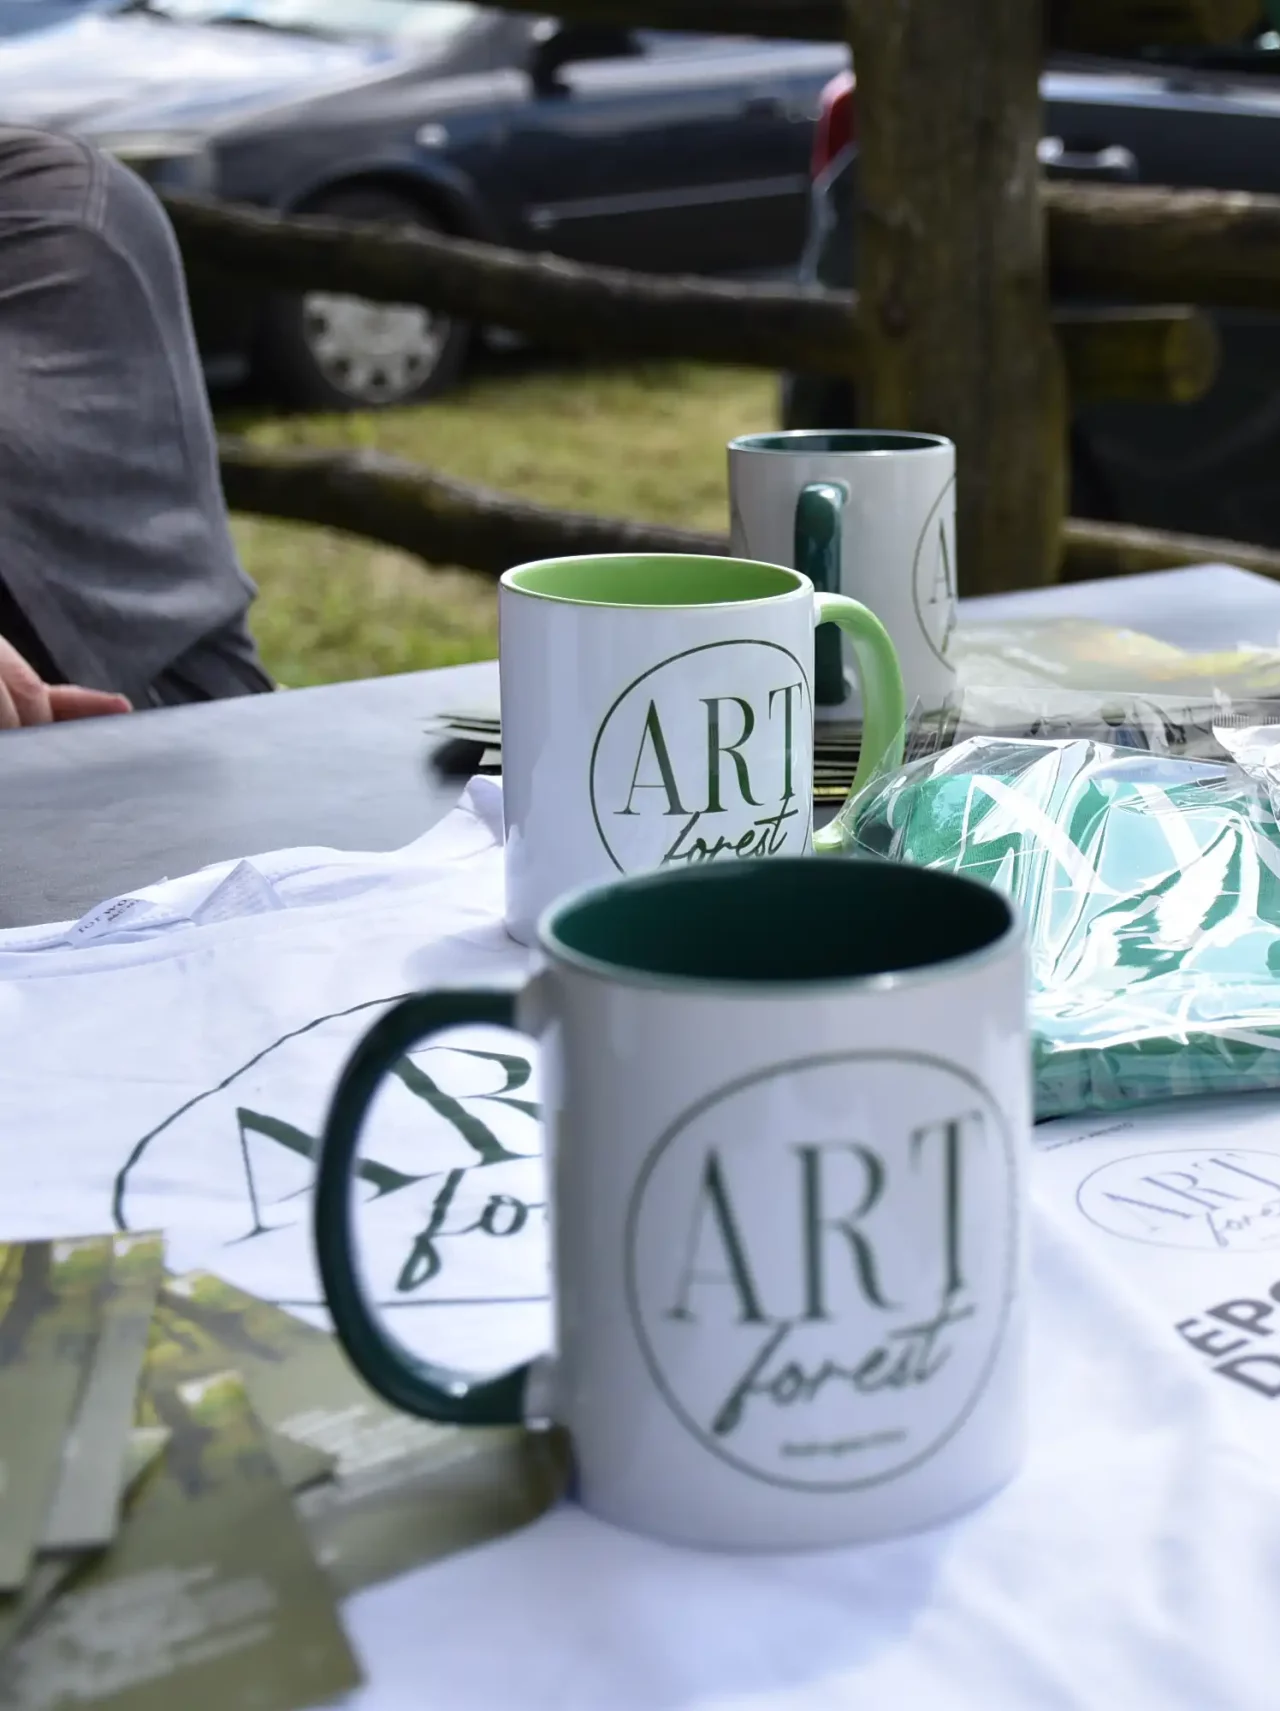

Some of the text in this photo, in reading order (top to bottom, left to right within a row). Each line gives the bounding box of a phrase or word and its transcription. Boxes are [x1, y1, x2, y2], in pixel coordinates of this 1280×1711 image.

[612, 682, 803, 815] ART
[658, 799, 798, 868] forest
[662, 1106, 988, 1326] ART
[710, 1292, 975, 1438] forest
